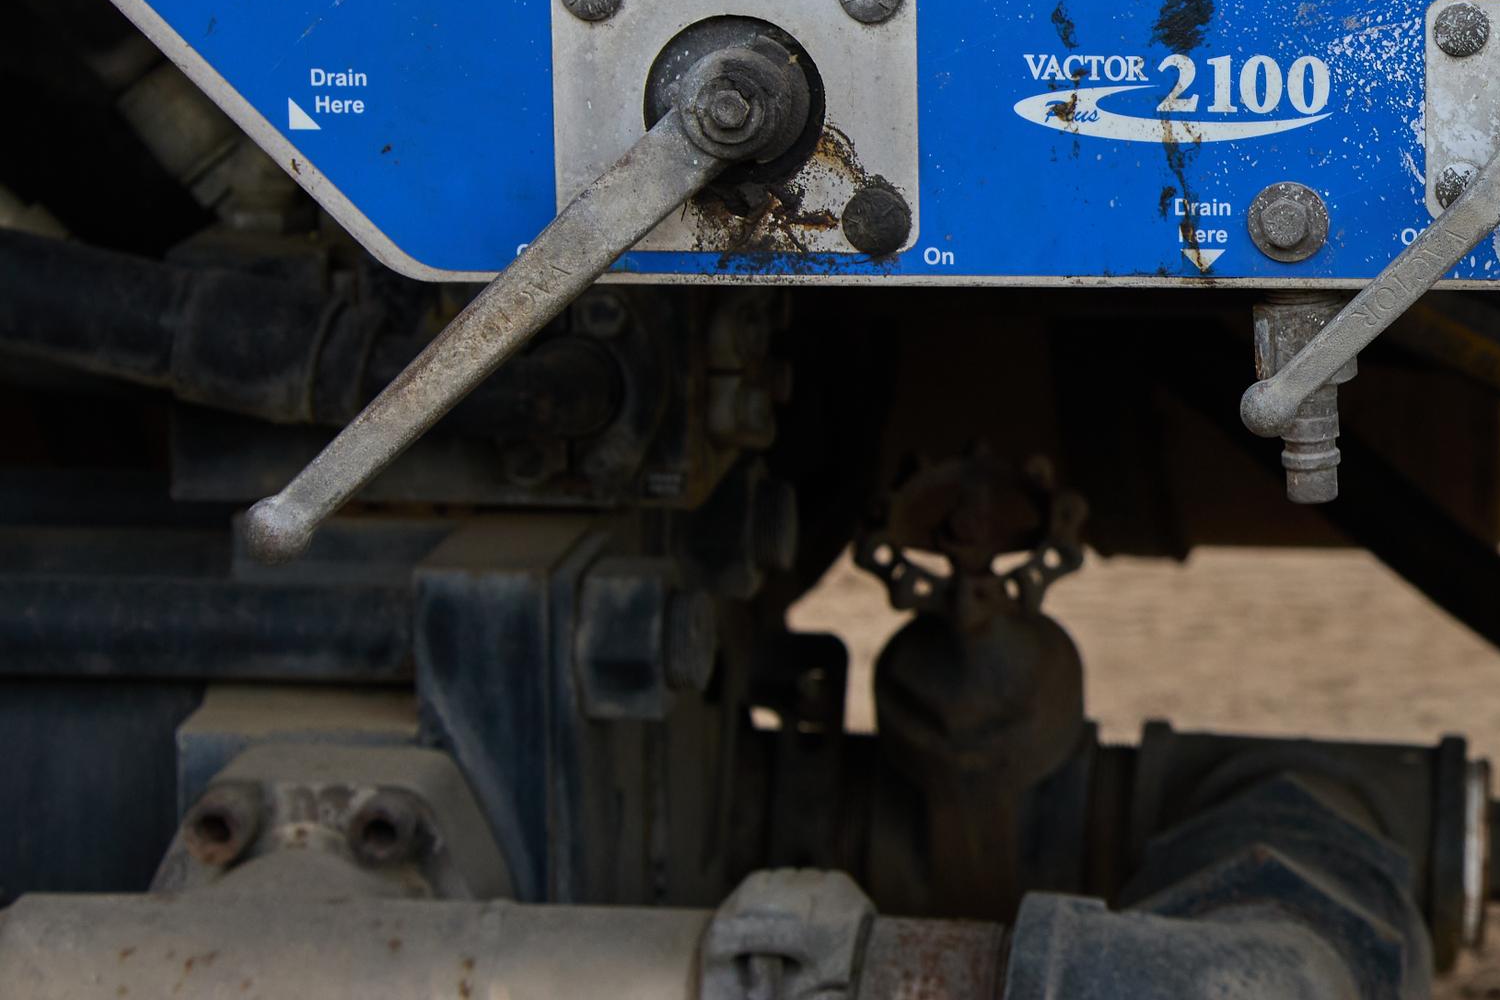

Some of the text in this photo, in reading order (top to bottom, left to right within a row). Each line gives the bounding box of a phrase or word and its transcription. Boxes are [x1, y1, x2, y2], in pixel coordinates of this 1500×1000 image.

[1024, 55, 1148, 81] VACTOR
[311, 69, 366, 86] Drain
[1157, 55, 1330, 114] 2100
[316, 96, 364, 113] Here
[1044, 100, 1100, 124] Pus
[1175, 198, 1231, 216] Drain
[924, 248, 954, 264] On
